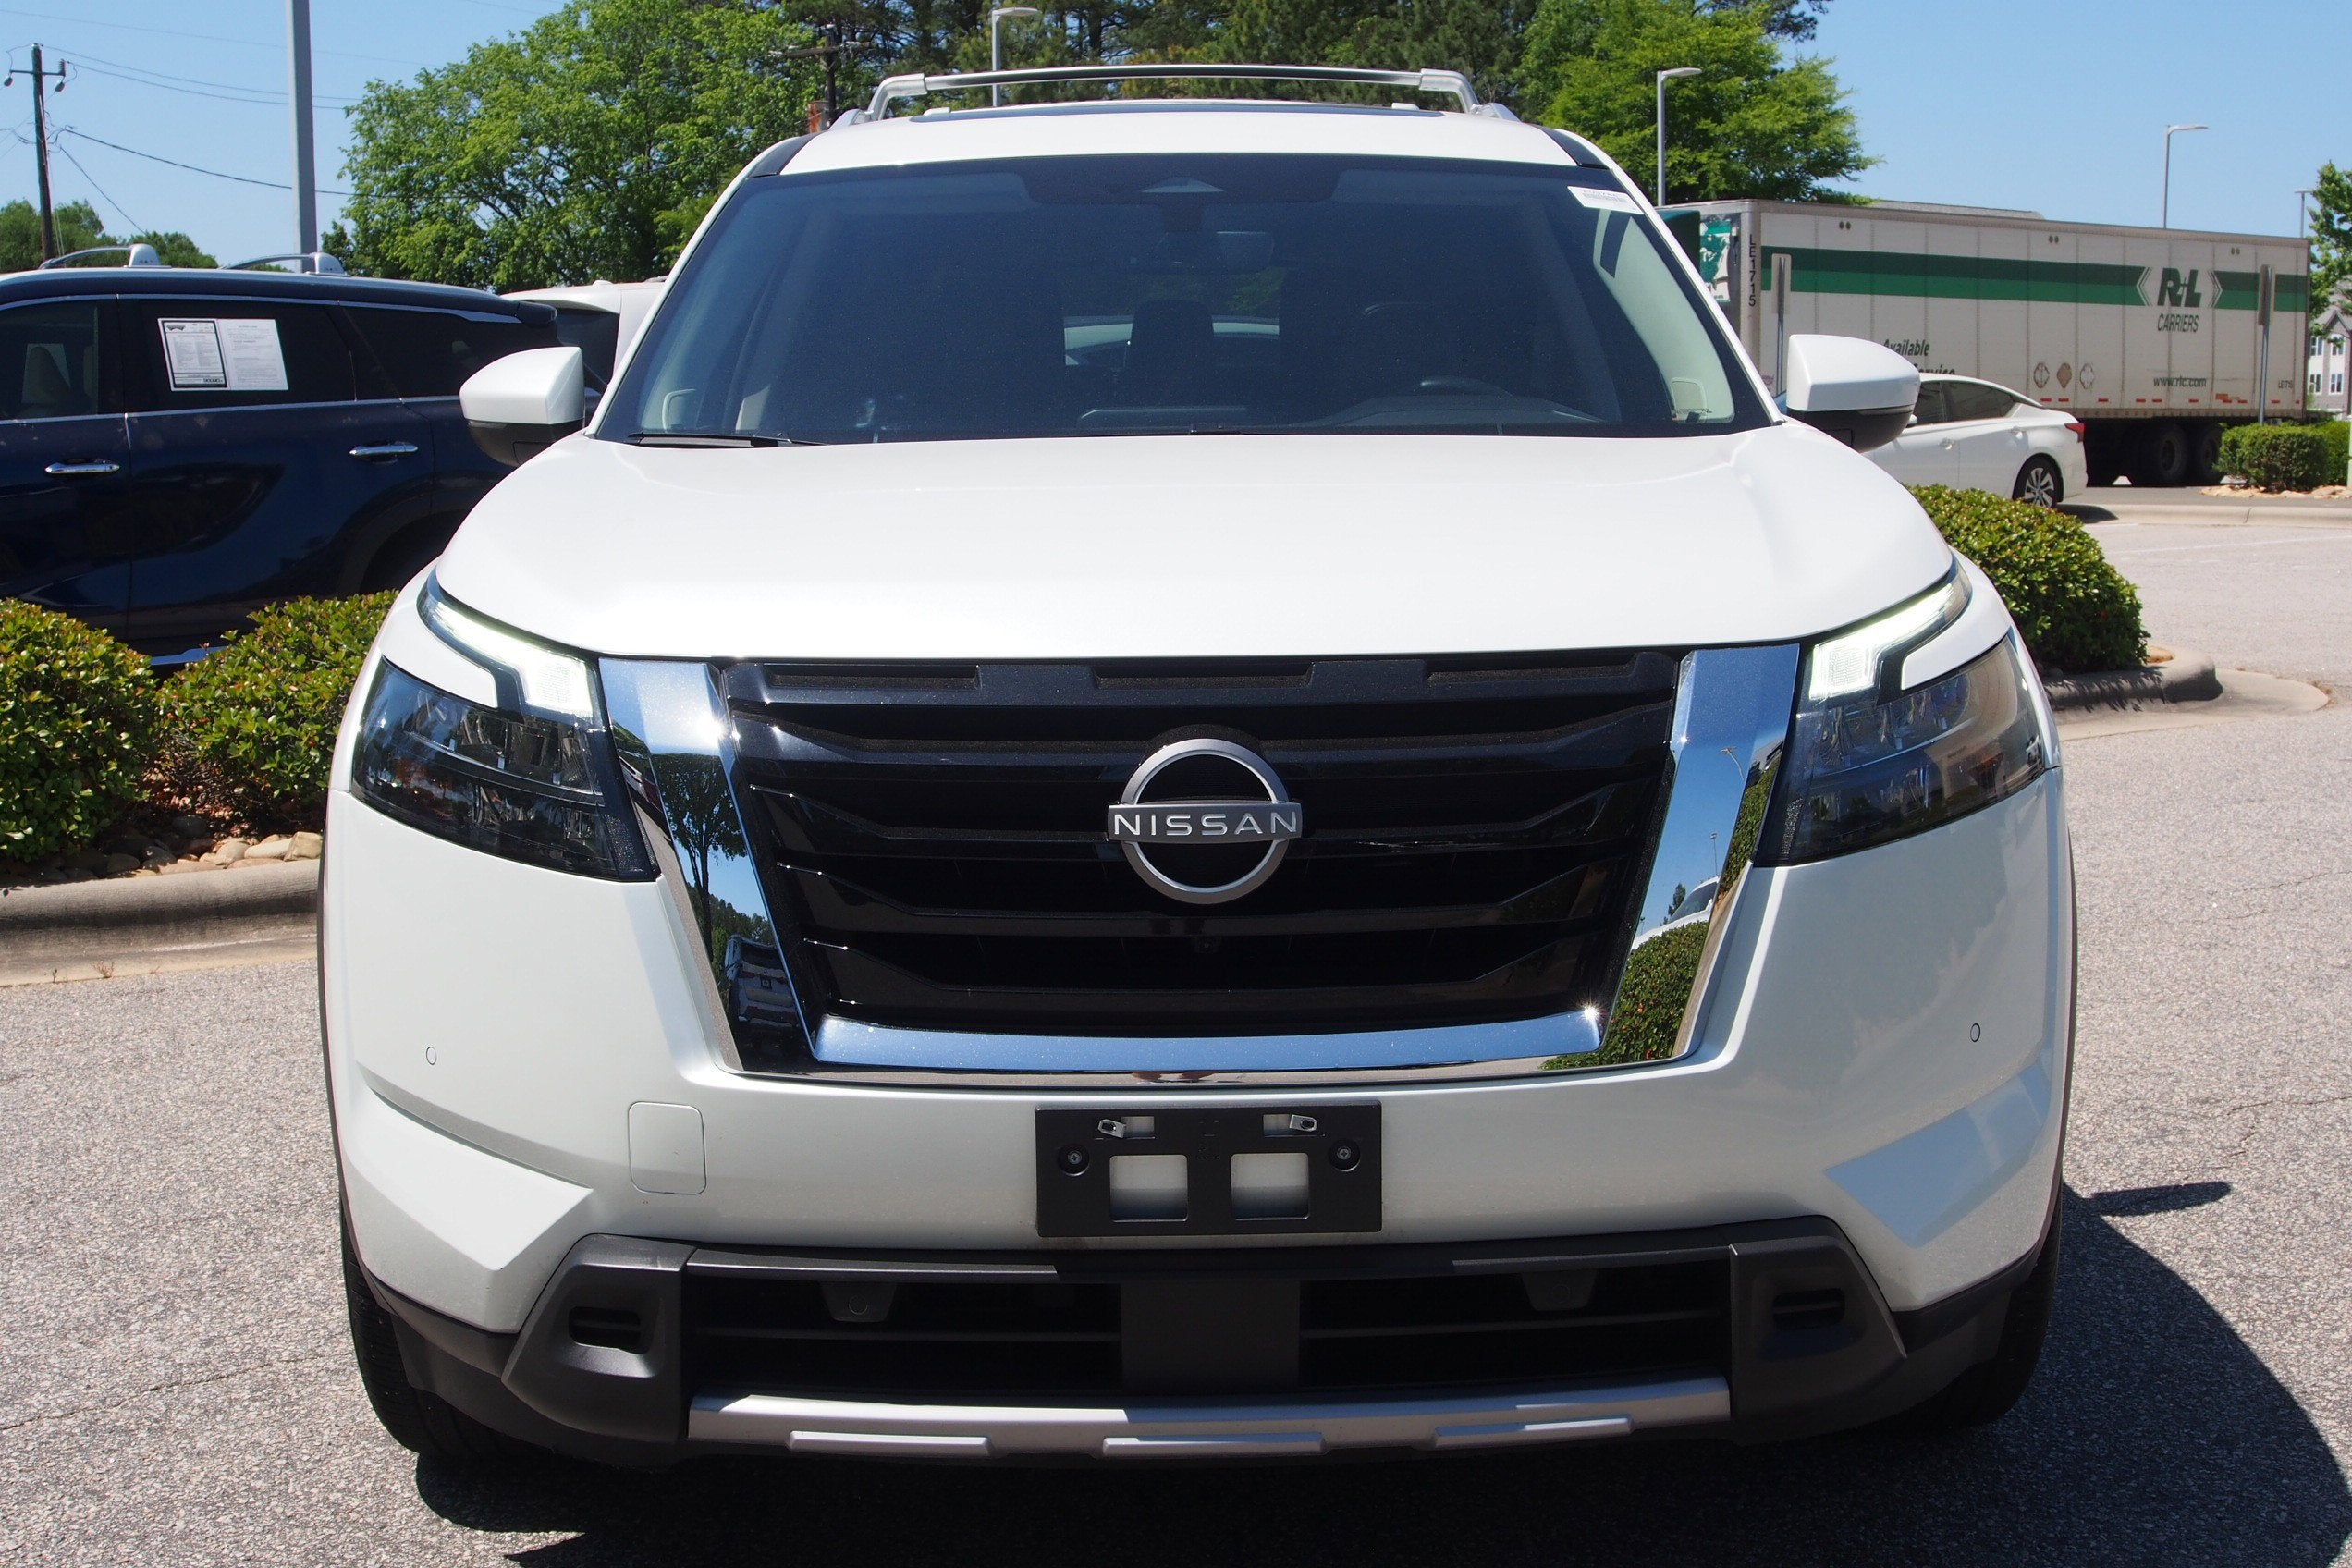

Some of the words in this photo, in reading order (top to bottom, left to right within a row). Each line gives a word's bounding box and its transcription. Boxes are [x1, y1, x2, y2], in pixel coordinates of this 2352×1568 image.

[1748, 234, 1757, 307] LE1715
[2157, 313, 2199, 333] CARRIERS
[2153, 375, 2207, 387] www.rlc.com
[1113, 811, 1298, 837] NISSAN
